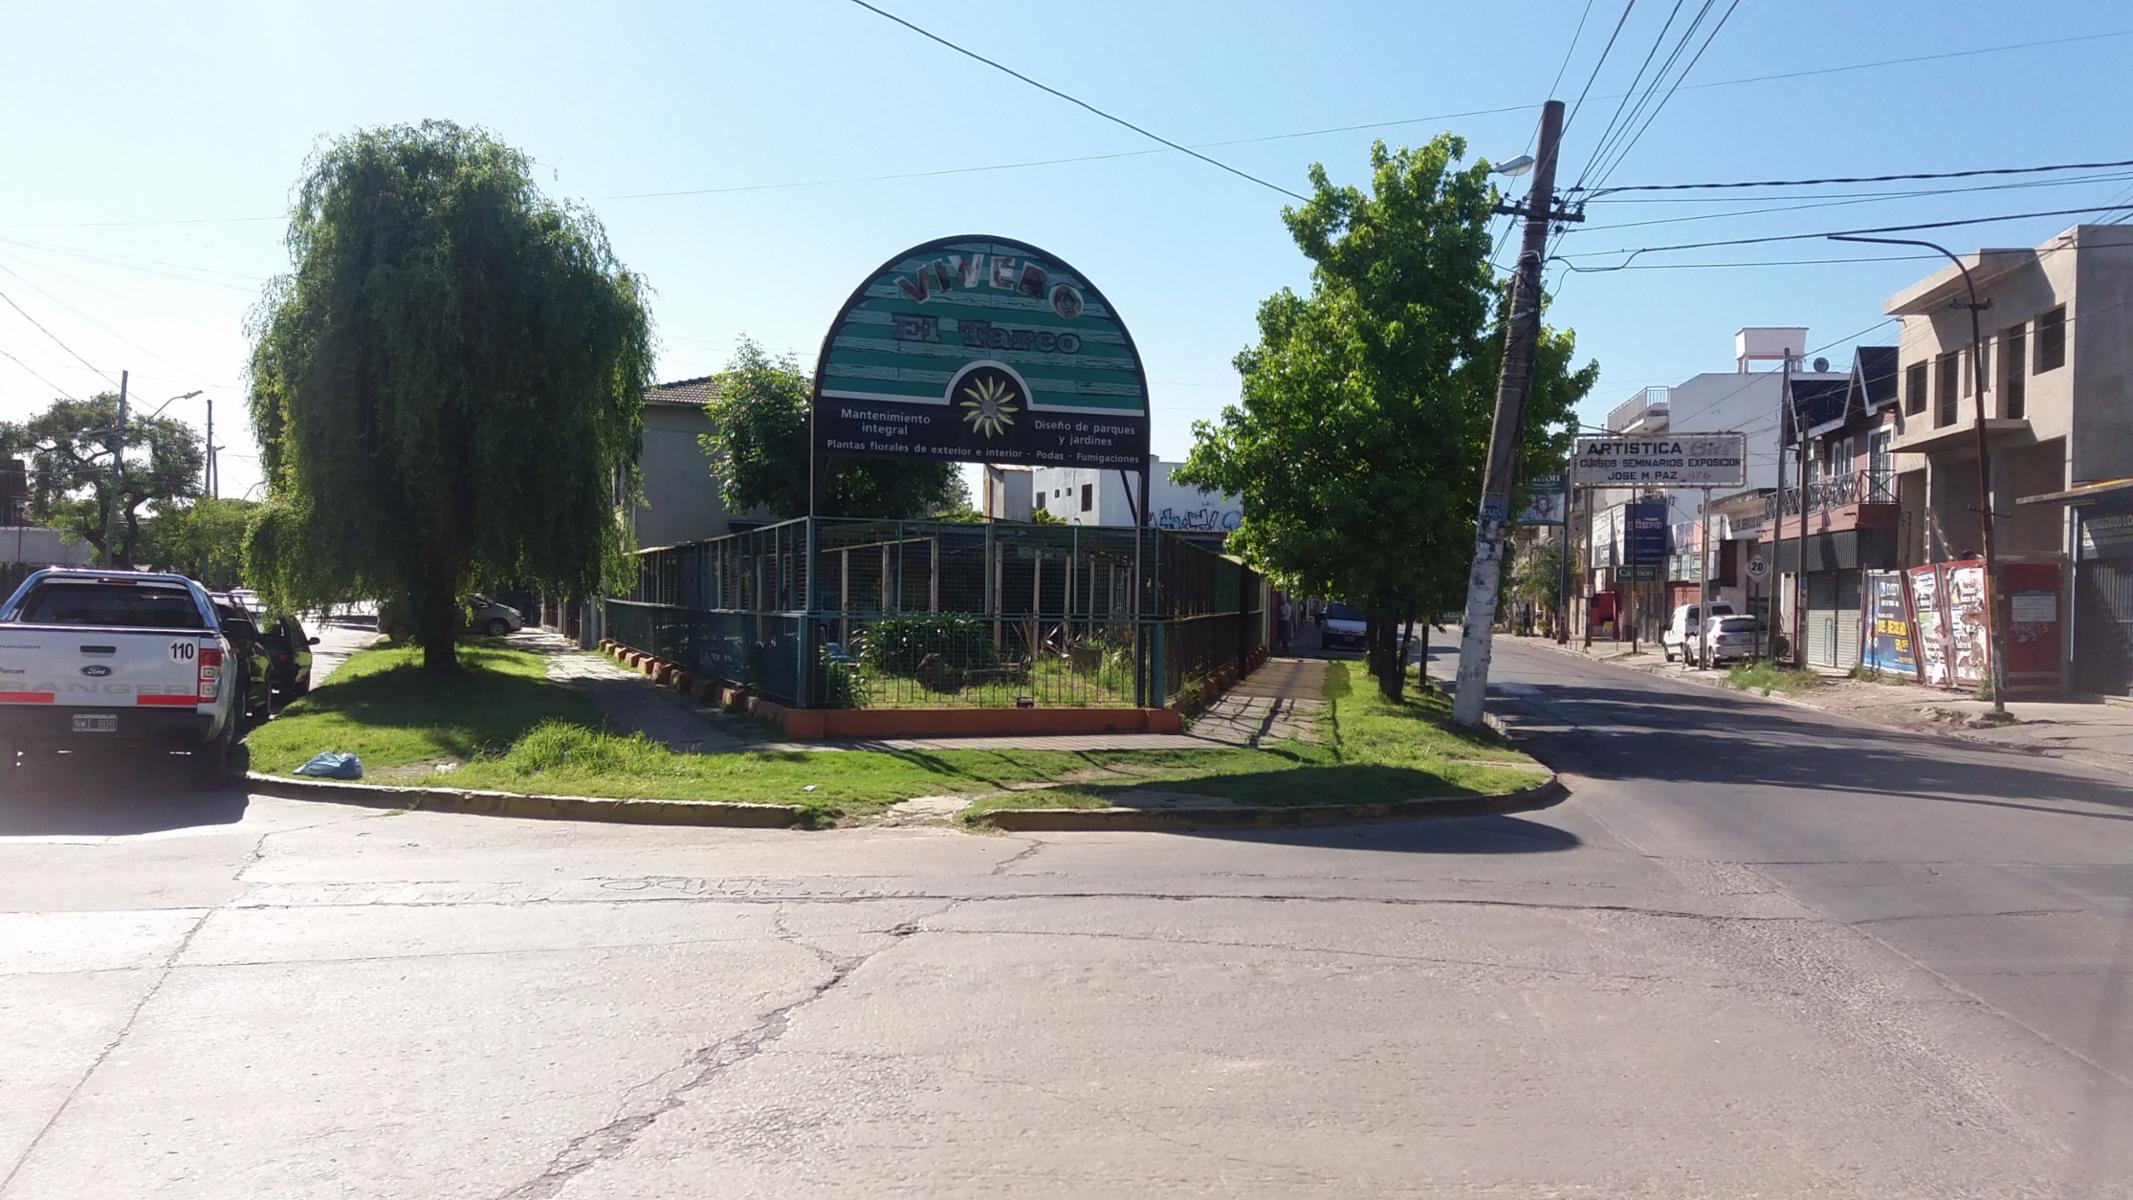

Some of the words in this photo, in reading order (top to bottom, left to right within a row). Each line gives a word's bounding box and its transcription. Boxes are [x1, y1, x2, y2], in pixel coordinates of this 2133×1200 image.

[893, 253, 1084, 320] VIVERO
[891, 313, 941, 343] El
[959, 320, 1081, 354] Tarco
[841, 408, 931, 425] Mantenimiento
[862, 422, 908, 436] integral
[1035, 420, 1071, 431] Diseño
[1075, 422, 1089, 432] de
[1093, 424, 1136, 436] parques
[1059, 435, 1065, 444] y
[1070, 434, 1112, 446] jardines
[827, 439, 865, 450] Plantas
[870, 441, 909, 453] florales
[914, 444, 927, 453] de
[931, 446, 971, 456] exterior
[986, 448, 1023, 458] interior
[1036, 450, 1064, 461] Podas
[1076, 452, 1139, 464] Fumigaciones
[1587, 442, 1683, 455] ARTISTICA
[1580, 458, 1617, 468] CURSOS
[1622, 458, 1684, 468] SEMINARIOS
[1608, 471, 1637, 480] JOSE
[1655, 471, 1678, 480] PAZ
[1751, 561, 1764, 572] 20
[170, 643, 194, 659] 110
